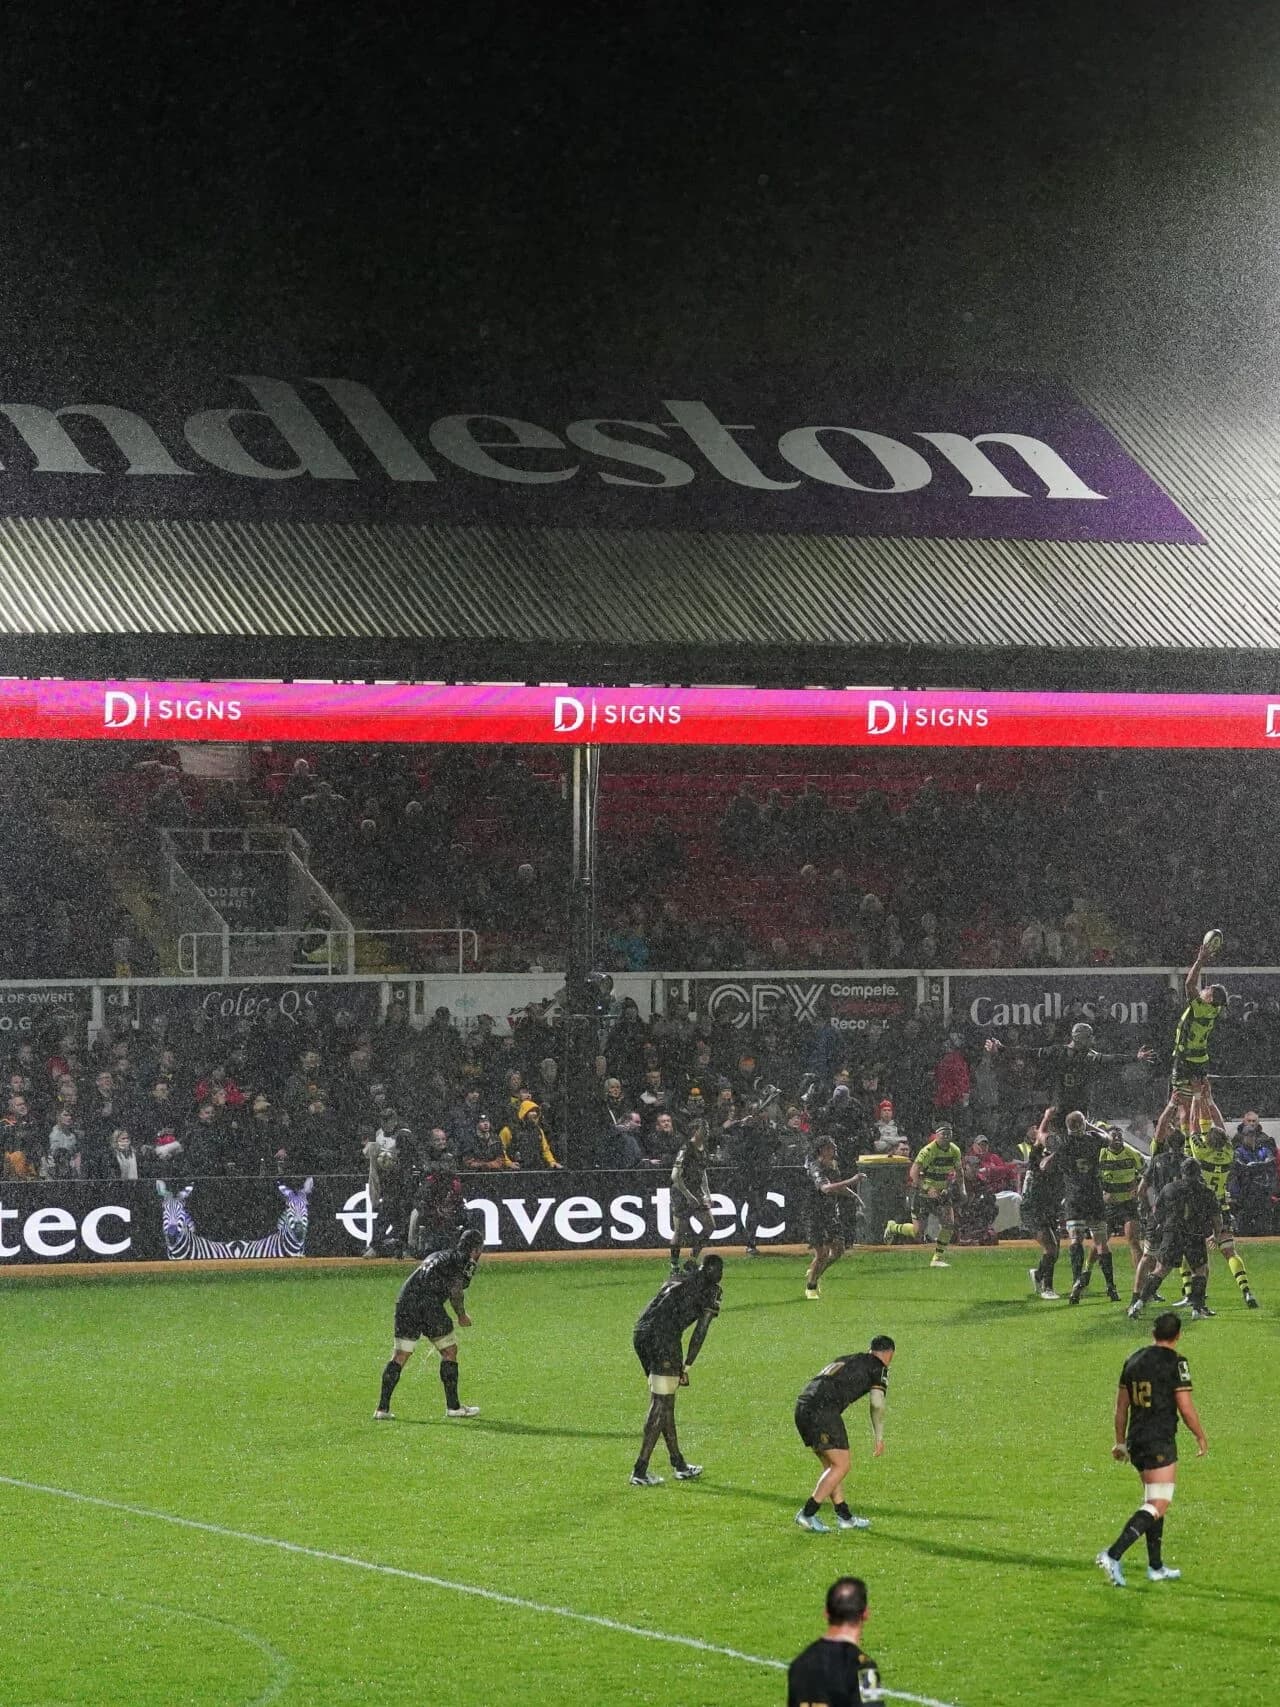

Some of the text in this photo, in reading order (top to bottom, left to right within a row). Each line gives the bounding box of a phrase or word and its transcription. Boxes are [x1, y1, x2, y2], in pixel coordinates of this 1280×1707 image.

[0, 375, 1109, 501] ndleston
[159, 700, 241, 720] SIGNS
[605, 705, 681, 723] SIGNS
[915, 708, 988, 726] SIGNS
[7, 993, 25, 1004] OF
[28, 993, 75, 1004] GWENT
[830, 984, 900, 998] Compete.
[970, 993, 1148, 1026] Candlson
[830, 1017, 890, 1030] Recor.
[463, 1187, 786, 1246] nvestec
[1131, 1380, 1153, 1408] 12
